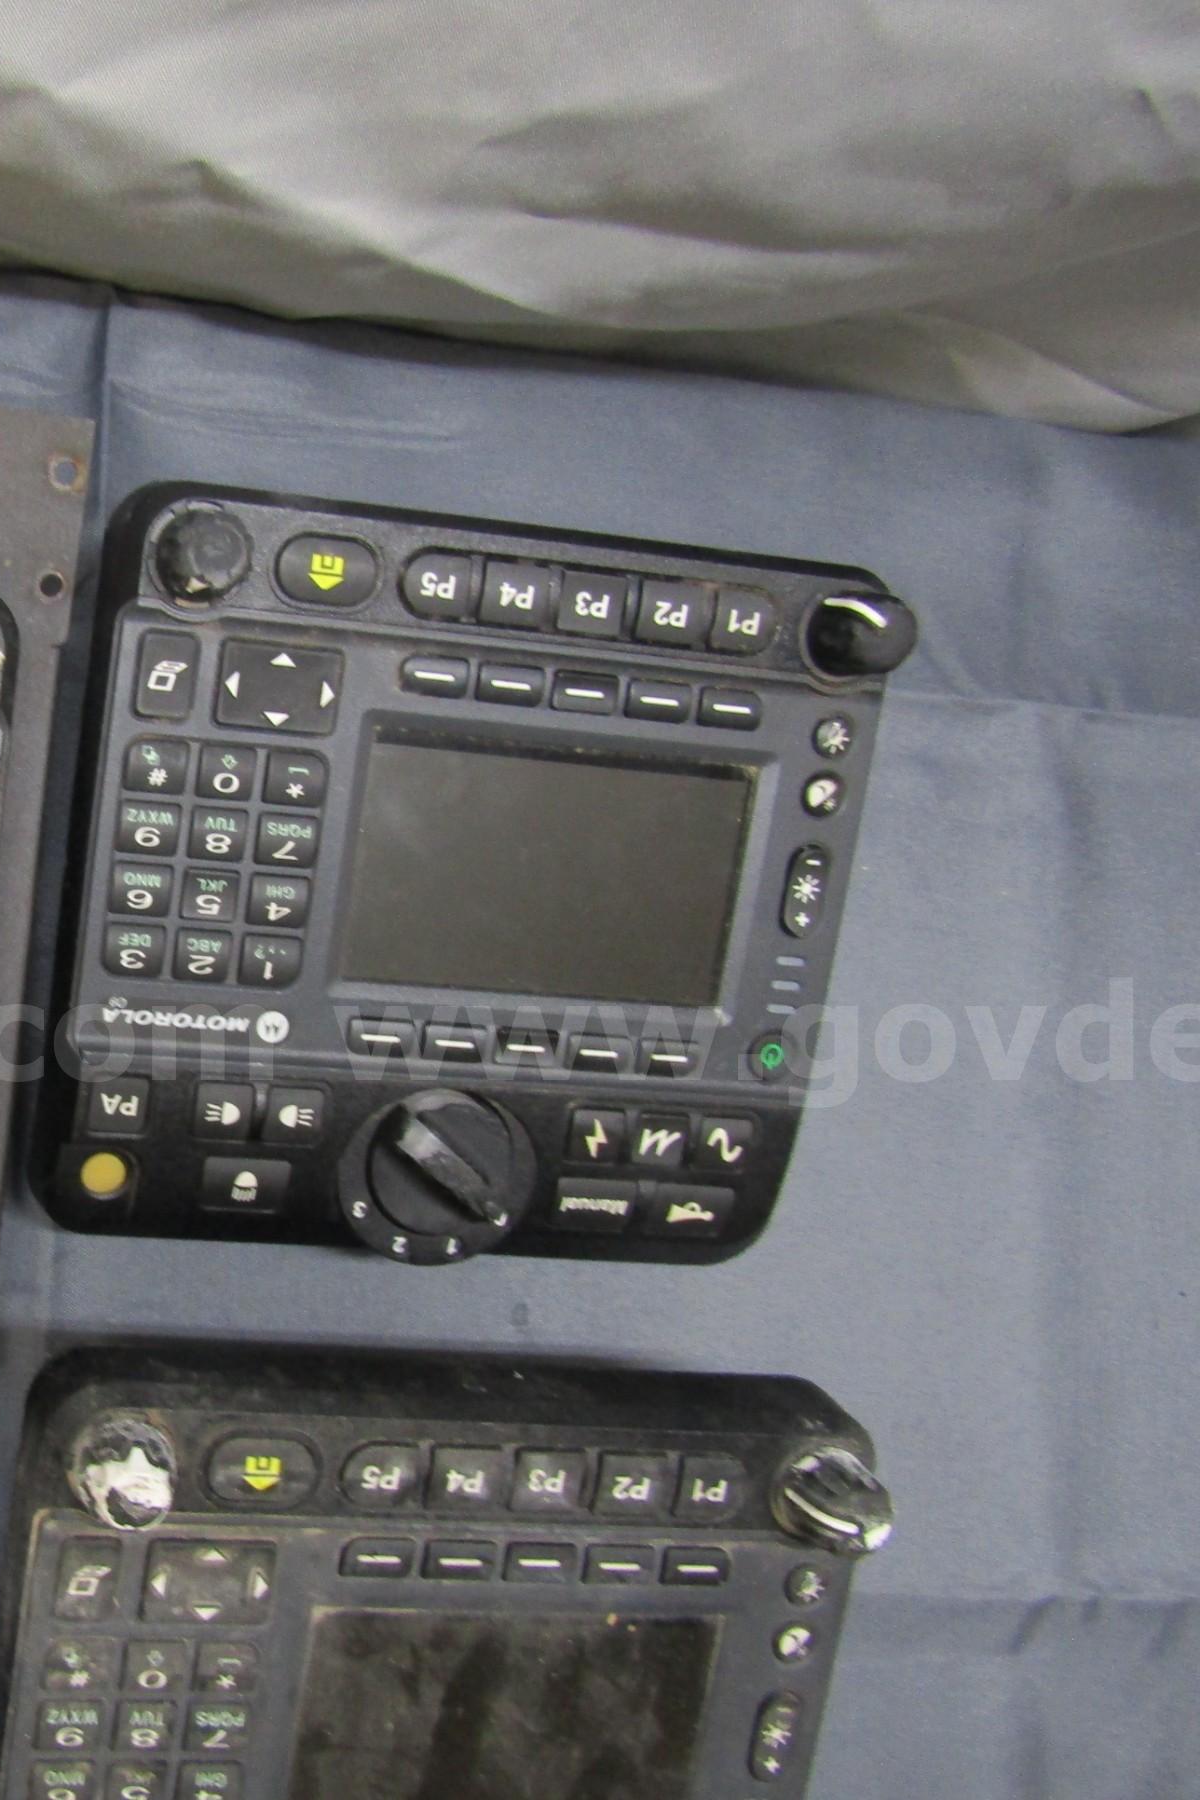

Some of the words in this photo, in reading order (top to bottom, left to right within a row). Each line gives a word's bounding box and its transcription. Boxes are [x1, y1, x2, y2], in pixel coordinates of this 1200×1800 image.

[420, 572, 457, 600] P5
[500, 582, 534, 610] P4
[575, 591, 610, 618] P3
[653, 601, 689, 628] P2
[728, 609, 761, 635] P1
[213, 772, 240, 793] 0
[127, 808, 174, 825] WXYZ
[204, 816, 237, 832] TUV
[135, 827, 160, 846] 9
[267, 822, 313, 839] PQRS
[205, 833, 231, 853] 8
[272, 841, 298, 860] 7
[123, 872, 162, 888] MNO
[196, 878, 228, 891] JKL
[127, 890, 153, 909] 6
[266, 884, 296, 898] GHI
[196, 895, 222, 915] 5
[265, 902, 291, 921] 4
[118, 933, 152, 947] DEF
[187, 938, 222, 951] ABC
[120, 949, 147, 969] 3
[188, 954, 216, 974] 2
[264, 961, 274, 980] 1
[102, 1007, 249, 1032] MOTOROLA
[101, 1093, 139, 1116] PA
[352, 1201, 368, 1218] 3
[392, 1236, 407, 1253] 2
[446, 1238, 457, 1255] 1
[361, 1465, 401, 1489] P5
[446, 1470, 484, 1493] P4
[527, 1469, 566, 1491] P3
[612, 1476, 649, 1500] P2
[692, 1479, 728, 1502] P1
[55, 1727, 84, 1747] 9
[131, 1728, 159, 1747] 8
[203, 1730, 230, 1748] 7
